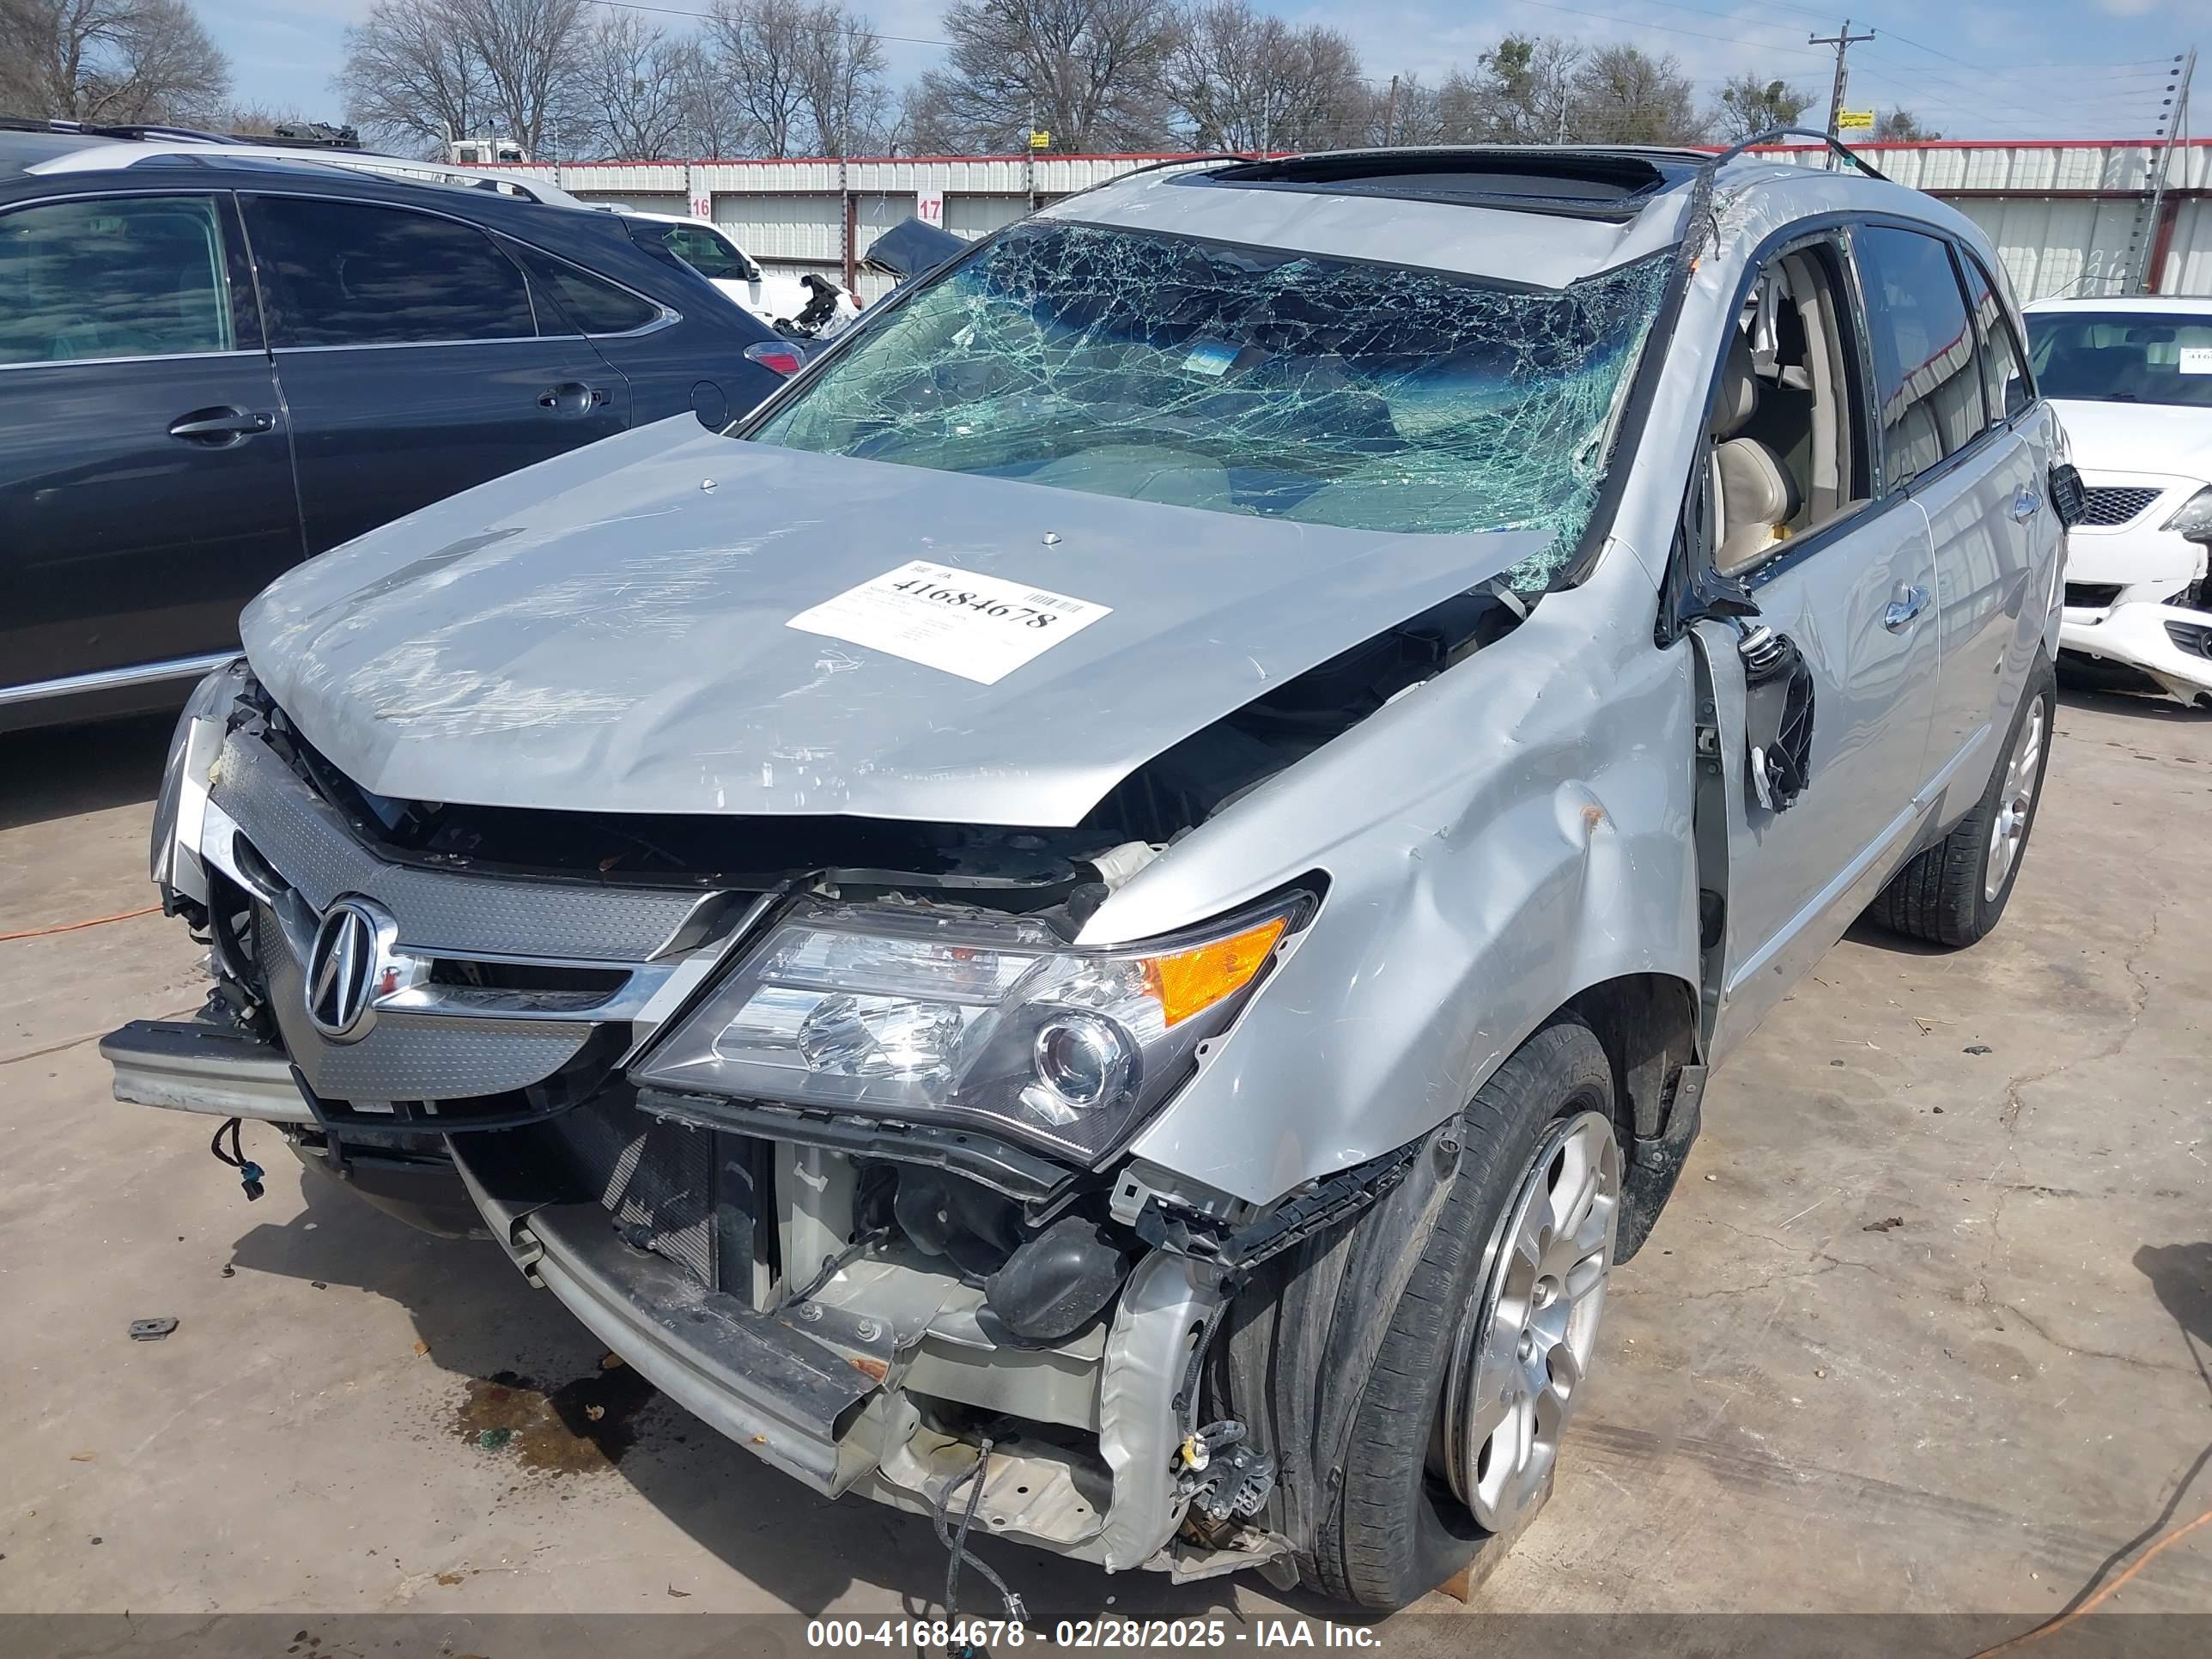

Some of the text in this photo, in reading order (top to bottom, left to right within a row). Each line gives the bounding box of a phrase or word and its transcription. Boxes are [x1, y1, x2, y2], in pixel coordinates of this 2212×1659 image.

[693, 198, 709, 216] 16
[921, 199, 941, 220] 17
[892, 580, 1057, 629] 41684678
